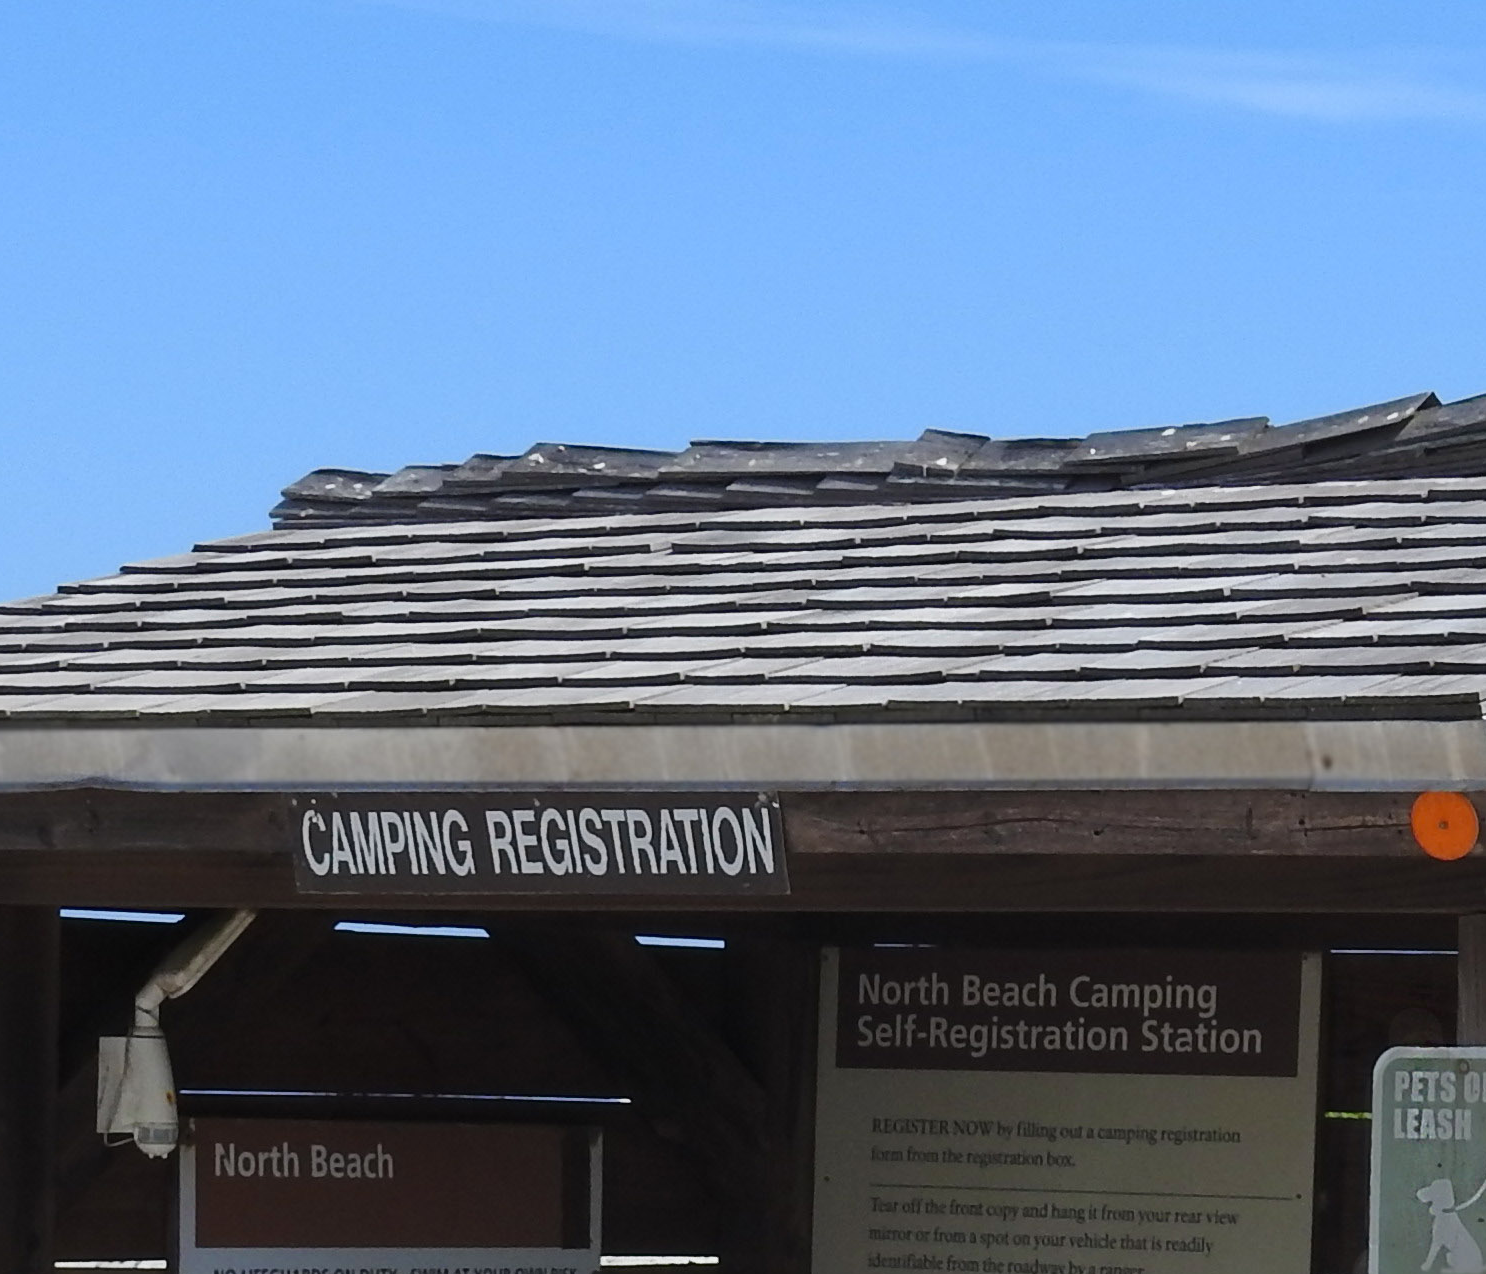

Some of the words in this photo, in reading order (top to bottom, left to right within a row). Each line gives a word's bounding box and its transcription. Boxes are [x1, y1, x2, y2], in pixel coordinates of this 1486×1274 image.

[302, 810, 475, 875] CAMPING
[485, 808, 774, 874] REGISTRATION
[859, 973, 949, 1005] North
[962, 974, 1056, 1006] Beach
[1069, 975, 1217, 1018] Camping
[857, 1015, 1127, 1057] Self-Registration
[1141, 1019, 1261, 1053] Station
[1394, 1070, 1456, 1102] PETS
[871, 1117, 949, 1135] REGISTER
[953, 1119, 994, 1136] NOW
[996, 1120, 1013, 1140] by
[1016, 1120, 1057, 1142] filling
[1059, 1125, 1083, 1139] out
[1097, 1126, 1157, 1145] camping
[1160, 1127, 1241, 1145] registration
[1393, 1107, 1471, 1139] LEASH
[215, 1142, 299, 1177] North
[311, 1144, 393, 1178] Beach
[906, 1145, 939, 1162] from
[941, 1147, 963, 1163] the
[966, 1150, 1043, 1168] registration
[1046, 1150, 1075, 1167] box.
[870, 1196, 898, 1212] Tear
[901, 1197, 923, 1214] off
[924, 1198, 946, 1214] the
[949, 1198, 983, 1216] front
[985, 1205, 1019, 1221] copy
[1022, 1202, 1048, 1218] and
[1051, 1202, 1085, 1224] hang
[1088, 1203, 1097, 1220] it
[1101, 1203, 1135, 1221] from
[1137, 1209, 1171, 1225] your
[1173, 1211, 1203, 1224] rear
[1205, 1209, 1239, 1225] view
[915, 1230, 931, 1242] or
[933, 1226, 966, 1243] from
[979, 1231, 1009, 1248] spot
[1012, 1233, 1030, 1246] on
[1033, 1234, 1066, 1250] your
[1069, 1232, 1117, 1249] vehicle
[1120, 1233, 1147, 1250] that
[1151, 1235, 1162, 1251] is
[1165, 1236, 1213, 1257] readily
[946, 1254, 979, 1272] from
[982, 1256, 1005, 1274] the
